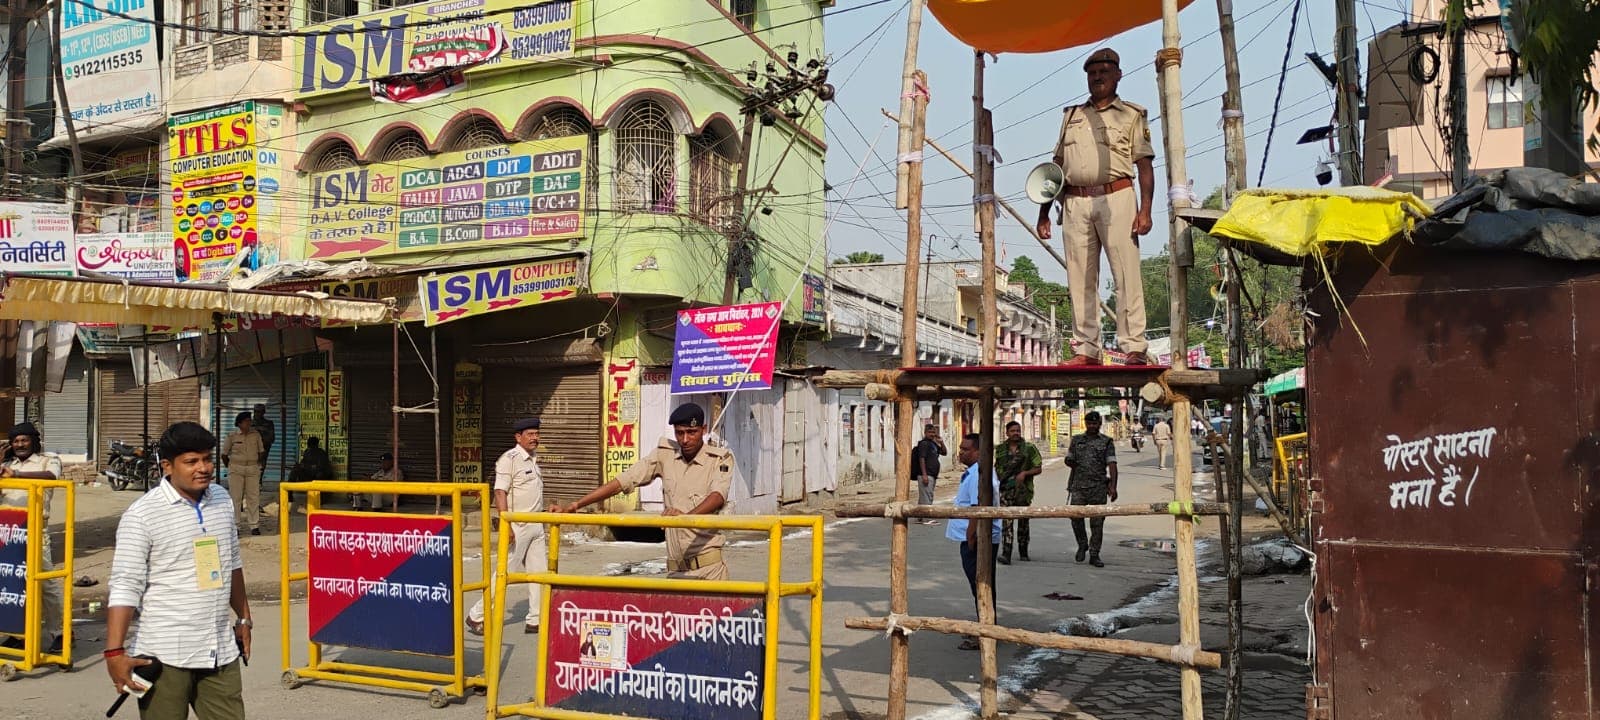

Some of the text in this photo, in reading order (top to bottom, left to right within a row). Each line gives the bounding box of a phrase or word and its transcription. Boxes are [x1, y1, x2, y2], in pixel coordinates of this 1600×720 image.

[300, 14, 408, 92] ISM
[512, 28, 571, 59] 8539910032
[74, 49, 143, 78] 9122115535
[177, 118, 249, 158] ITLS
[173, 154, 211, 174] COMPUTER
[212, 150, 253, 168] EDUCATION
[466, 147, 510, 160] COURSES
[405, 153, 577, 187] DCA ADCA DIT ADIT
[312, 169, 369, 209] ISM
[404, 191, 439, 206] TALLY
[447, 186, 477, 202] JAVA
[495, 180, 522, 196] DTP
[348, 206, 393, 220] College
[403, 210, 437, 225] PGDCA
[444, 205, 480, 221] AUTOCAD
[311, 228, 322, 240] के
[445, 228, 478, 241] B.Com
[492, 222, 523, 237] B.Lis
[556, 217, 577, 232] Safety
[134, 262, 174, 270] UNIVERSITY
[427, 269, 512, 312] ISM
[301, 377, 325, 395] ITLS
[680, 371, 762, 387] सिवान पुलिस
[454, 447, 481, 462] ISM
[605, 450, 635, 461] COMP
[1382, 427, 1497, 475] पोस्टर साटना
[455, 465, 478, 474] COMP
[1389, 479, 1436, 509] मना
[312, 526, 338, 549] जिला
[338, 530, 366, 555] सड़क
[366, 532, 394, 558] सुरक्षा
[313, 577, 355, 597] यातायात
[357, 576, 388, 597] नियमों
[390, 582, 402, 599] का
[404, 583, 430, 602] पालन
[665, 672, 685, 704] का
[687, 673, 731, 706] पालन
